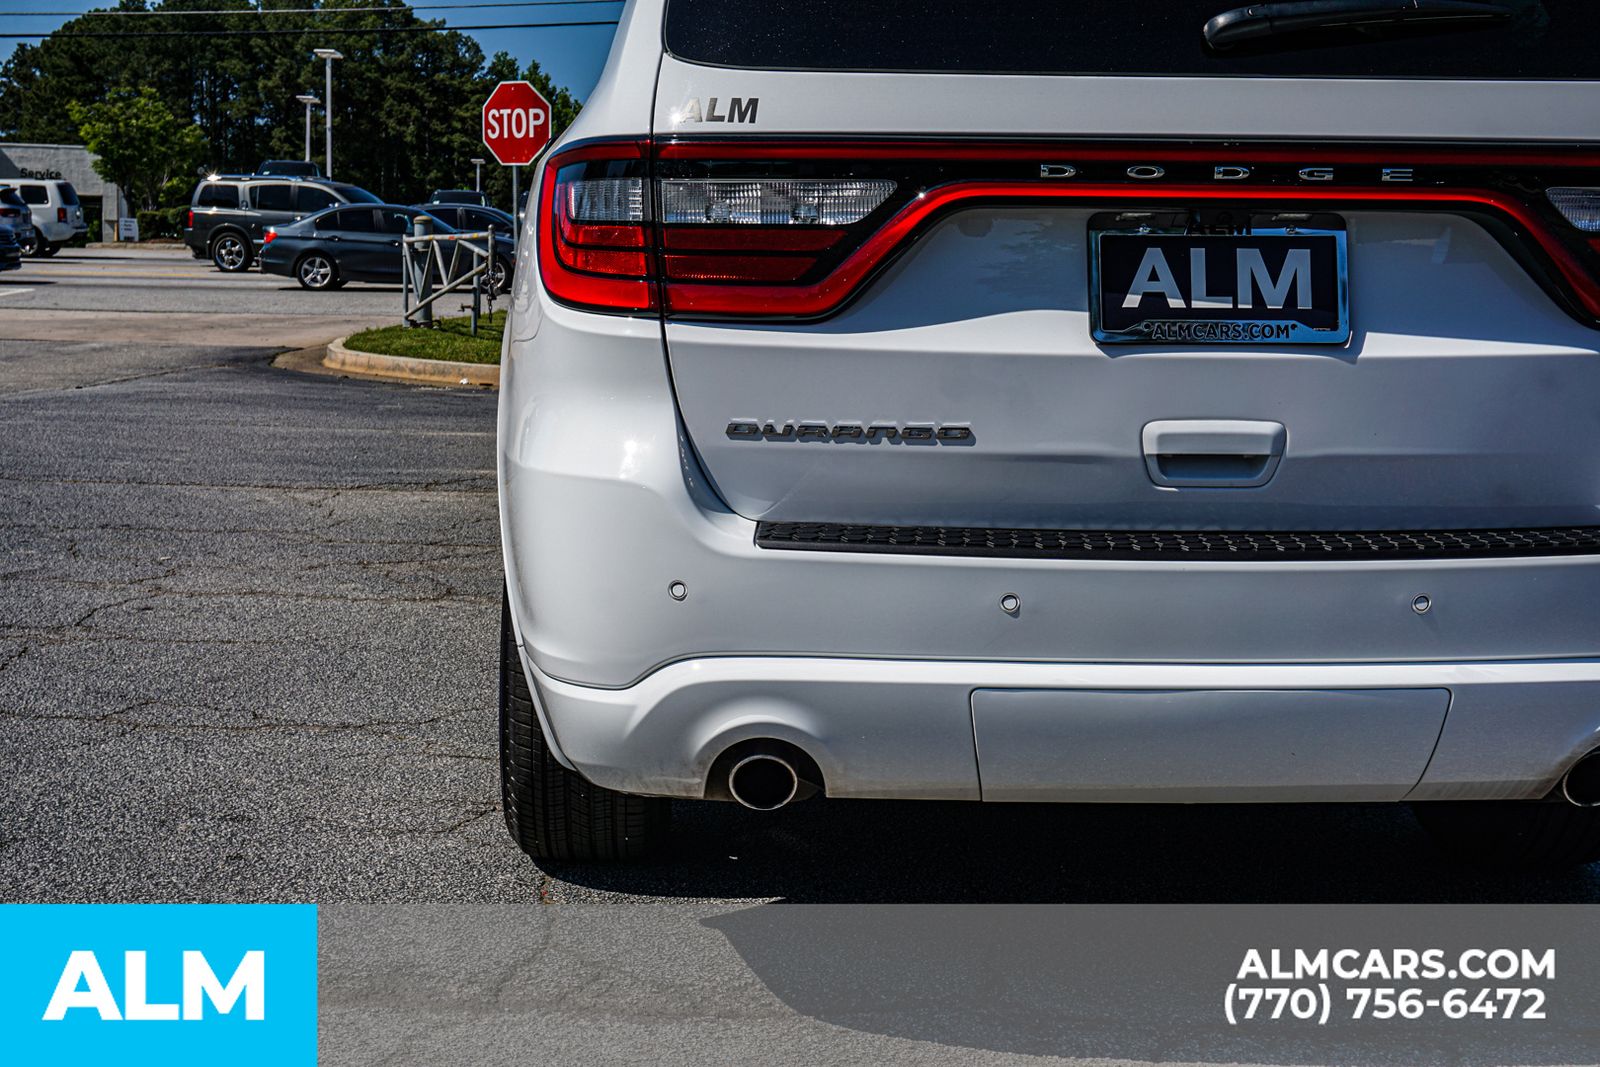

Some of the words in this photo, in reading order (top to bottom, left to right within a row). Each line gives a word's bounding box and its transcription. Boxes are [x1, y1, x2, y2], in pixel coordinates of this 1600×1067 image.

[681, 97, 760, 124] ALM
[487, 108, 546, 140] STOP
[20, 168, 62, 180] Service
[1040, 164, 1414, 182] DODGE
[1122, 247, 1312, 309] ALM
[1151, 323, 1291, 340] ALMCARS.COM
[725, 418, 973, 443] DURANGO
